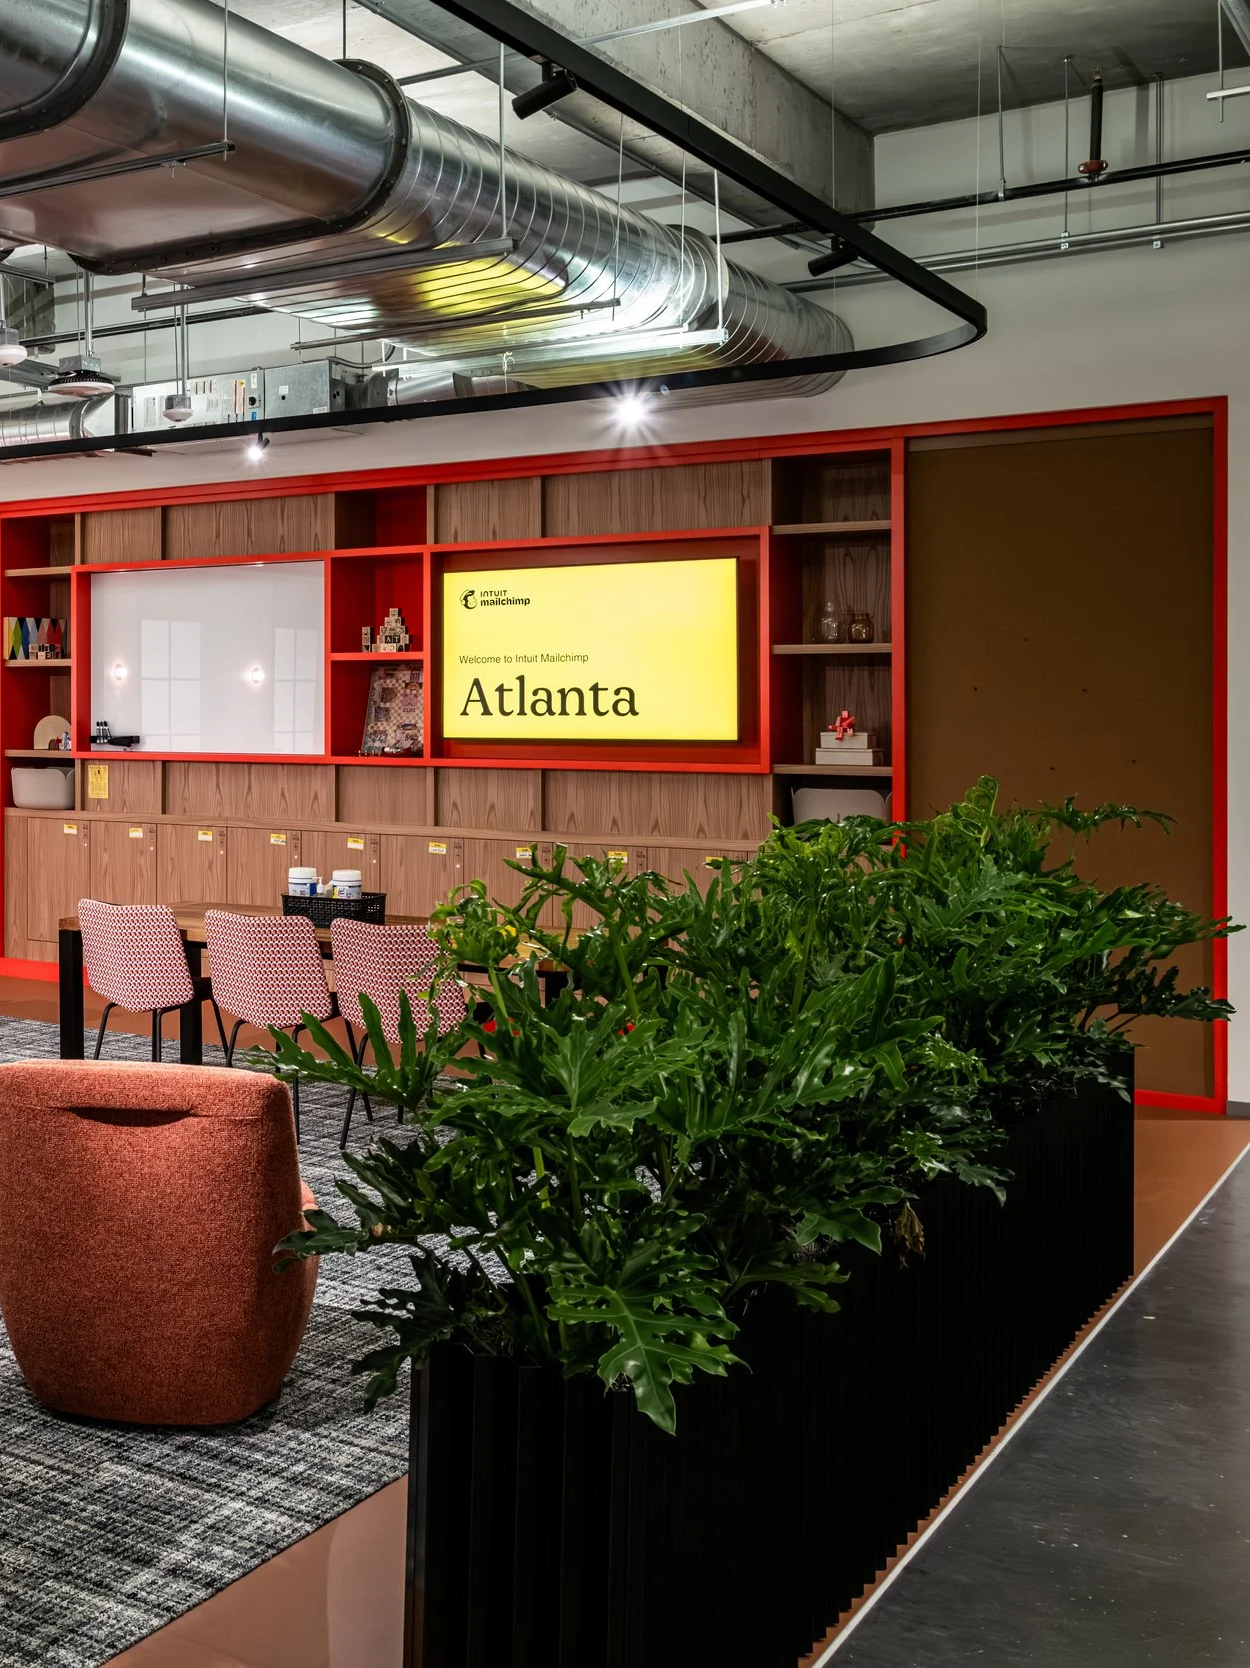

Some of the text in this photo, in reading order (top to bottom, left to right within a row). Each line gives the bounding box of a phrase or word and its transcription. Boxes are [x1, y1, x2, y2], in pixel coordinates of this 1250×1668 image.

[480, 589, 507, 598] INTUIT
[480, 597, 531, 607] mailchimp
[459, 653, 589, 664] Welcome to Intuit Mailchimp
[459, 674, 640, 717] Atlanta
